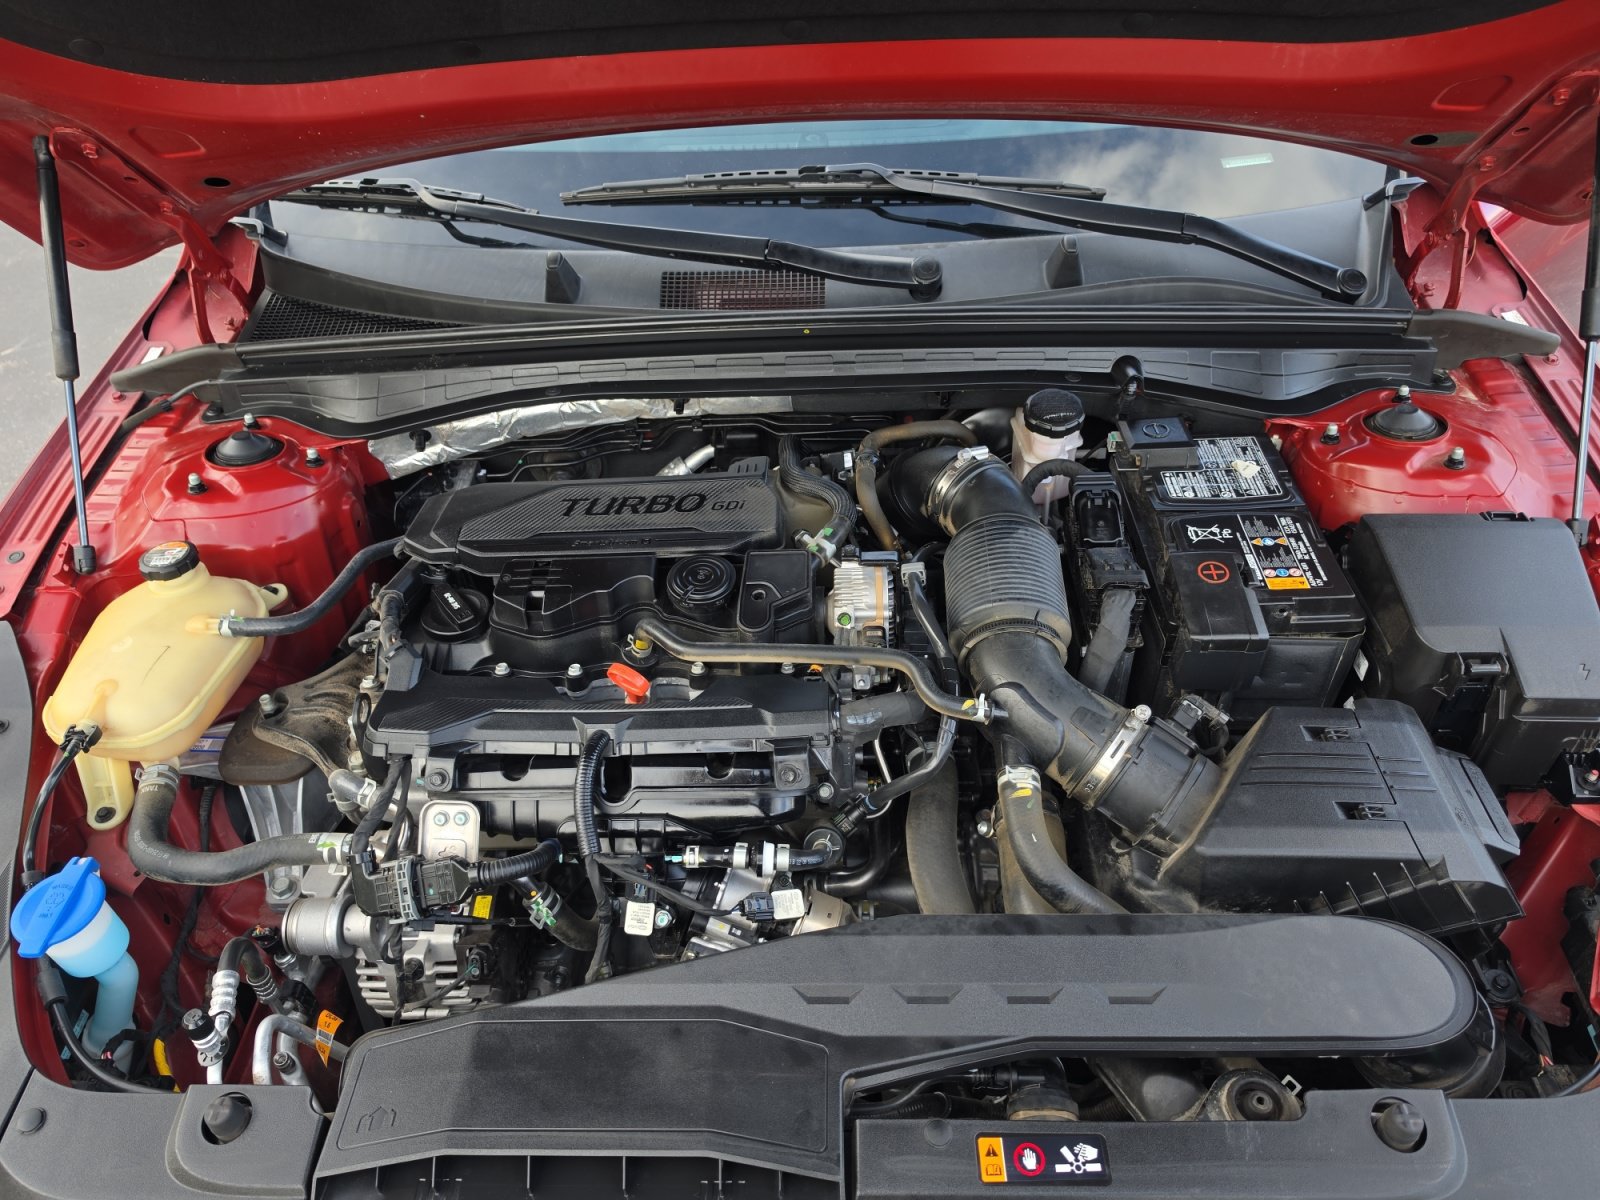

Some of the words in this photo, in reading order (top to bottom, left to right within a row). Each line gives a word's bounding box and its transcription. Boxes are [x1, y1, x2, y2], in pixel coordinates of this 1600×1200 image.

[560, 492, 707, 517] TURBO
[711, 500, 745, 511] GDi
[1222, 528, 1233, 538] Pb
